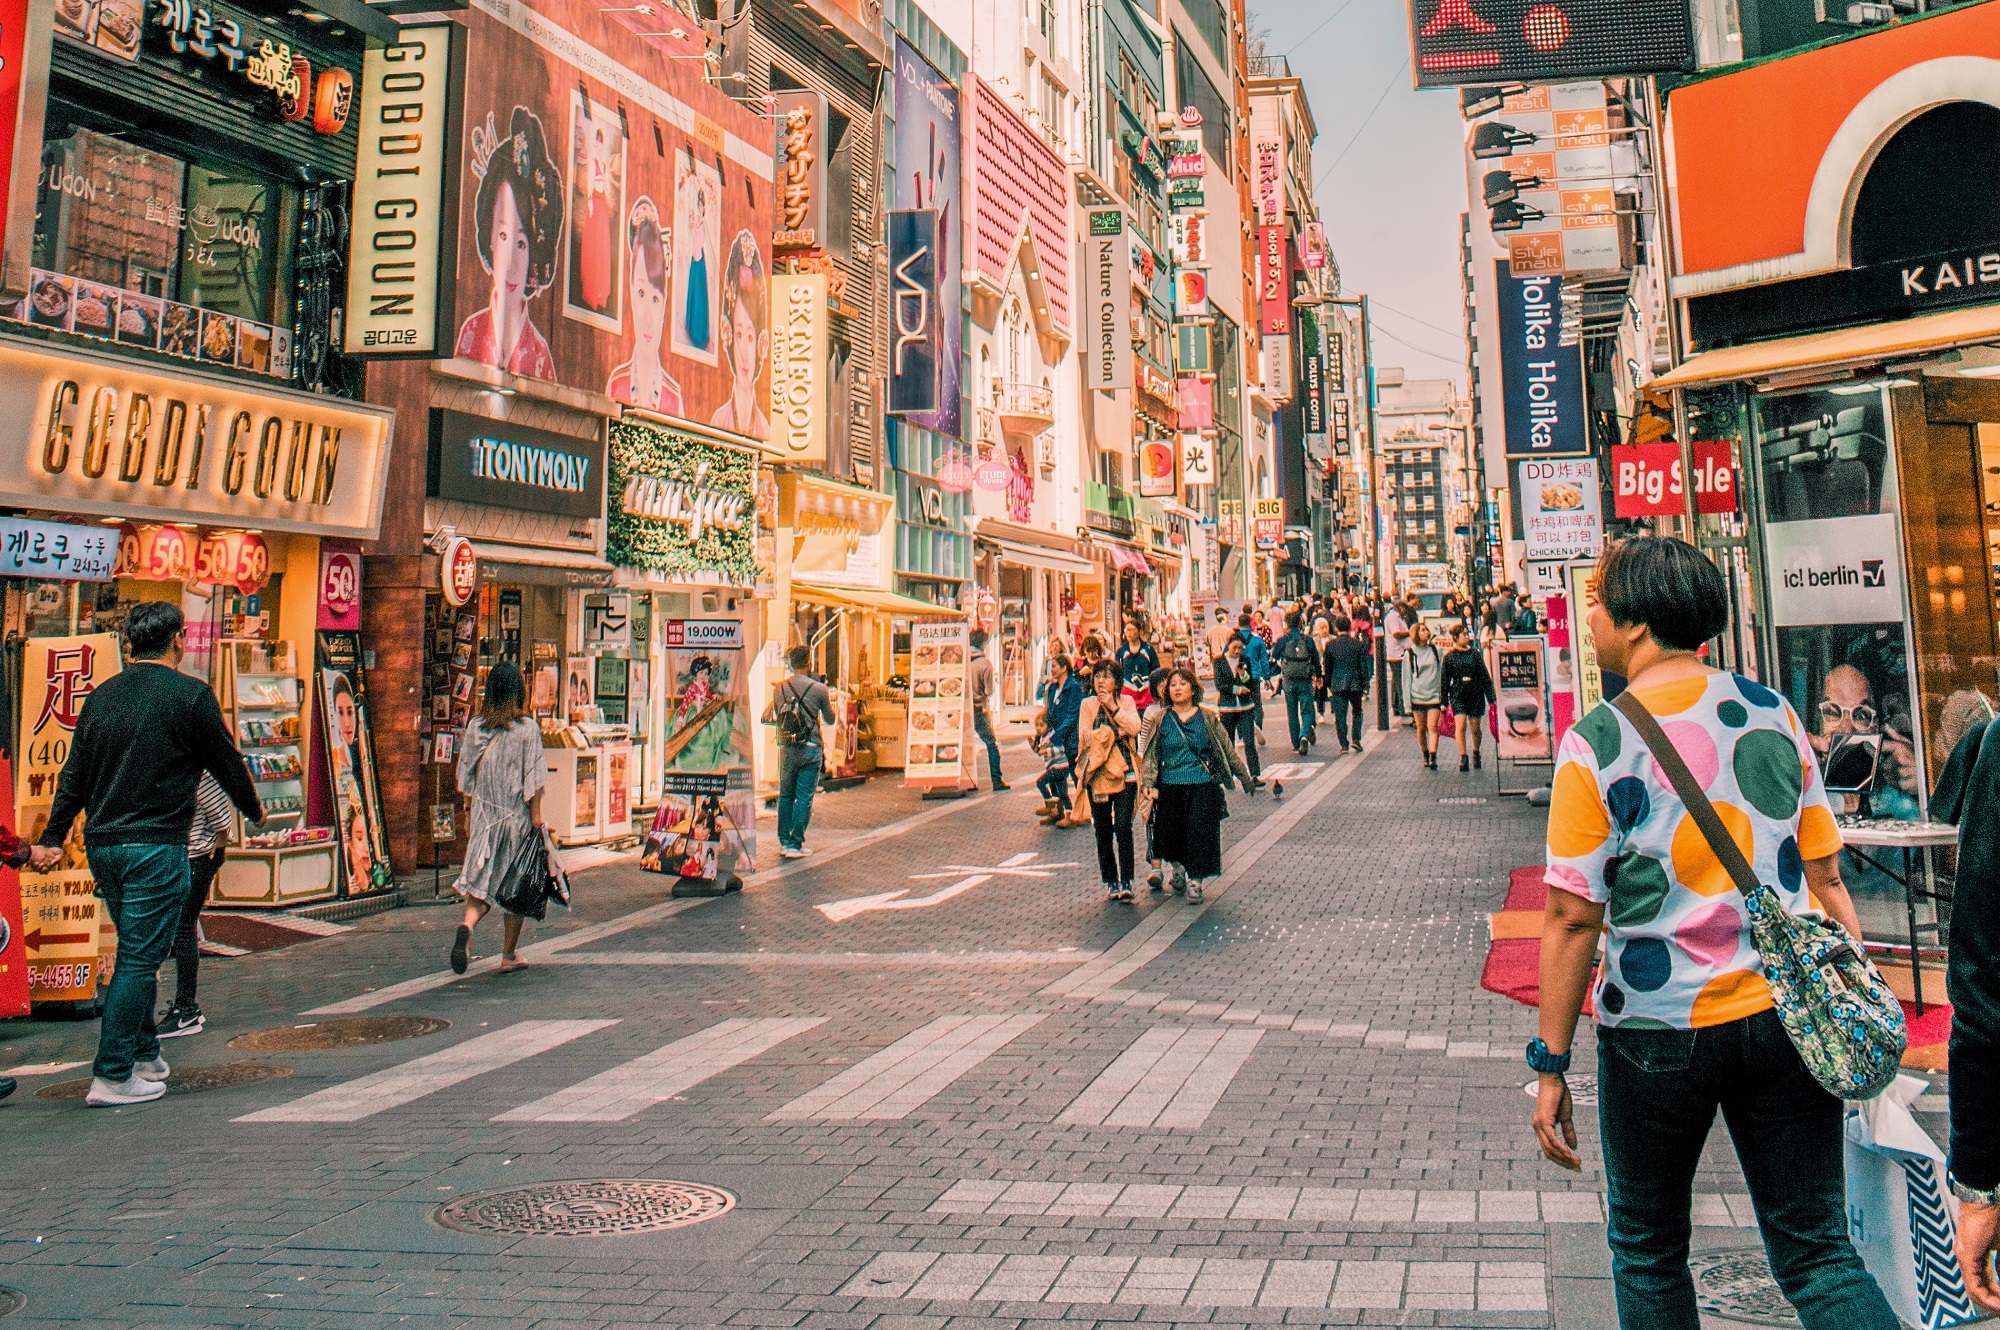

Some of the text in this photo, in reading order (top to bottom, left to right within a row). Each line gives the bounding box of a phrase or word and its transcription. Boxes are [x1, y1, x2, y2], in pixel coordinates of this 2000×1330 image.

[900, 56, 921, 91] VDL
[1504, 98, 1545, 110] mall
[1257, 143, 1279, 153] TBC
[1561, 134, 1603, 146] mall
[1167, 158, 1205, 174] Mud
[370, 40, 426, 316] GOBDI GOUN
[1567, 214, 1610, 226] mall
[774, 230, 814, 243] 오다리집
[187, 243, 217, 267] うどん
[1515, 246, 1557, 259] style
[1265, 229, 1282, 300] 준오헤어 2
[1516, 257, 1559, 270] mall
[1902, 253, 2000, 296] KAIS
[895, 246, 927, 376] VDL
[1100, 240, 1115, 383] Nature Collection
[1271, 319, 1286, 333] 3F
[364, 329, 418, 346] 곱디고운
[773, 325, 785, 374] since
[788, 284, 814, 450] SKINFOOD
[1308, 357, 1320, 431] HOLLYS COFFEE
[1528, 360, 1558, 448] Holika
[42, 380, 341, 505] GOBDI GOUN
[482, 437, 590, 492] TONYMOLY
[1185, 446, 1208, 472] 光
[980, 471, 1007, 479] ETUDE
[1527, 463, 1554, 479] DD
[1618, 457, 1731, 504] Big Sale
[918, 485, 949, 523] VDL
[1258, 502, 1280, 514] BIG
[1258, 520, 1281, 534] MART
[1529, 515, 1596, 529] 炸鸡和啤酒
[84, 537, 106, 555] 우동
[1535, 530, 1592, 543] 可以 打包
[8, 529, 70, 570] 겐로쿠
[1529, 547, 1568, 557] CHICKEN
[1574, 547, 1591, 555] PUB
[71, 558, 110, 577] 꼬치구이
[1783, 565, 1859, 588] ic! berlin
[566, 572, 612, 587] TONYMOLY
[918, 627, 961, 638] 乌达里家
[32, 642, 97, 736] 足
[27, 964, 73, 988] 5-4455
[75, 963, 91, 987] 3F
